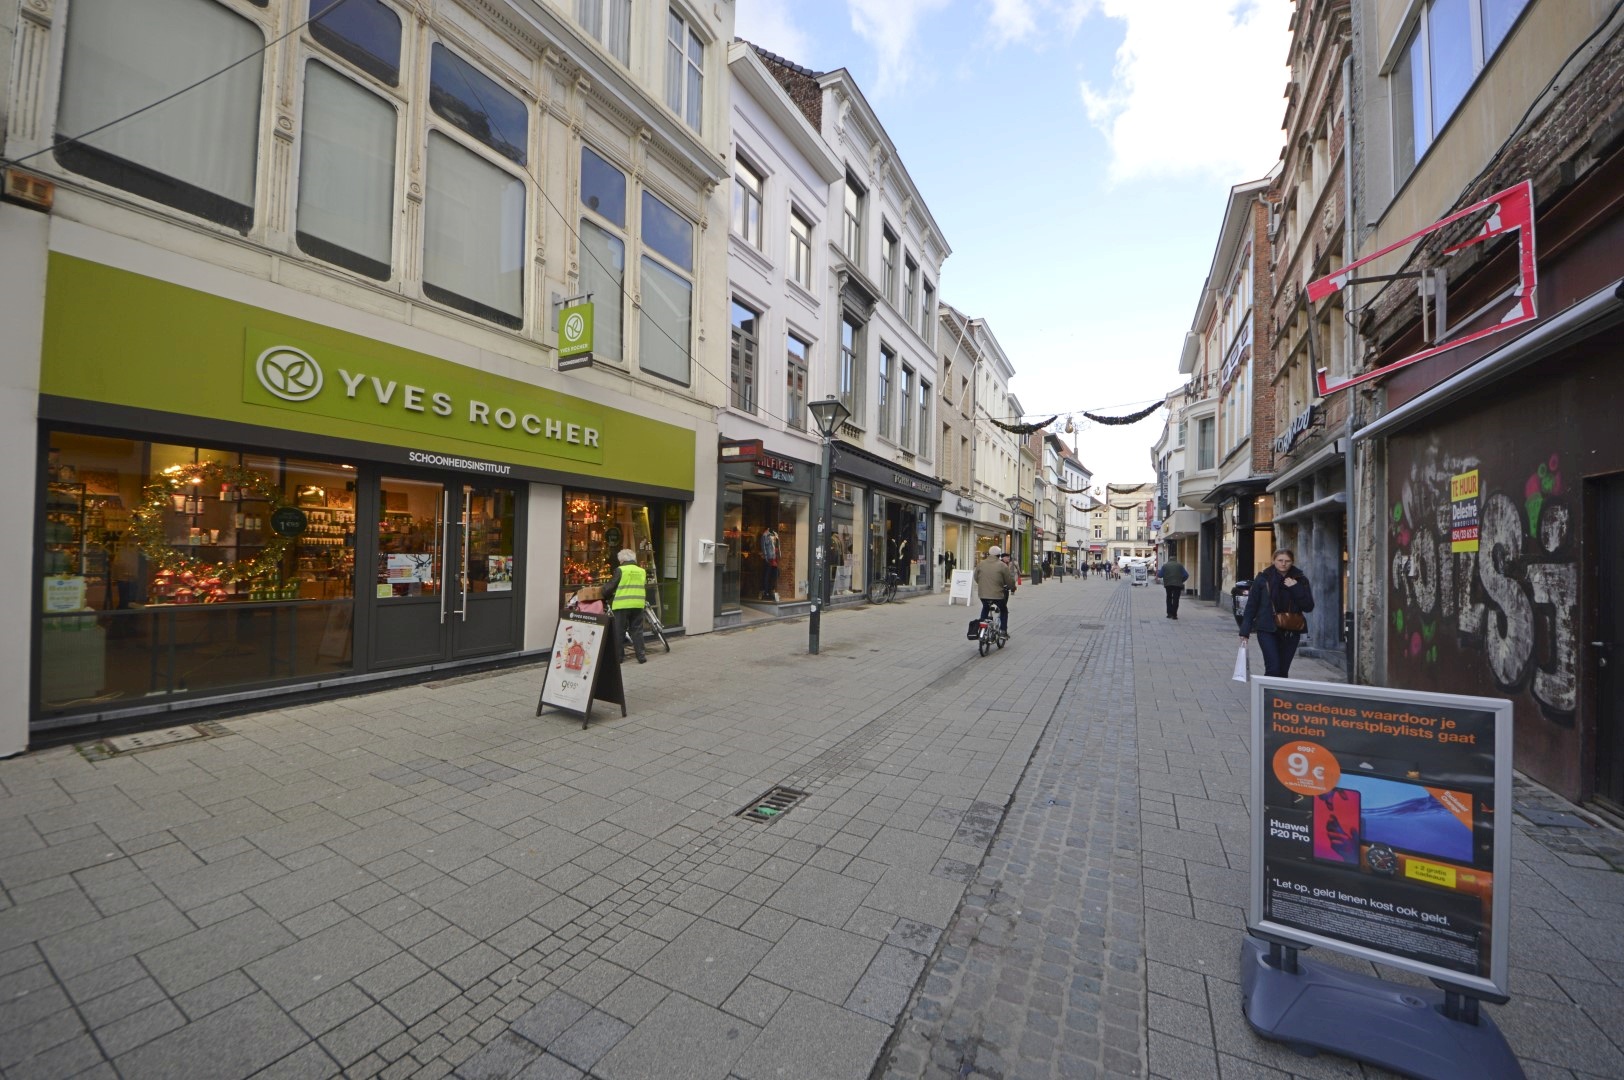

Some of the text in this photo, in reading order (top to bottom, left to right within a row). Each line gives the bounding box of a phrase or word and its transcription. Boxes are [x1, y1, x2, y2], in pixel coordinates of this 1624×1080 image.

[338, 368, 600, 448] YVES ROCHER
[408, 451, 511, 476] SCHOONHEIDSINSTITUUT
[1452, 475, 1477, 497] TE HUUR
[1452, 499, 1477, 520] Delestré
[1273, 697, 1456, 730] De cadeaus waardoor je
[1273, 711, 1476, 744] nog van kerstplaylists gaat
[1273, 721, 1326, 737] houden
[1270, 818, 1309, 833] Huawei
[1270, 828, 1310, 843] P20 Pro
[1313, 888, 1336, 898] geld
[1338, 891, 1367, 906] lenen
[1370, 898, 1394, 912] kost
[1396, 905, 1418, 918] ook
[1420, 912, 1450, 926] geld.
